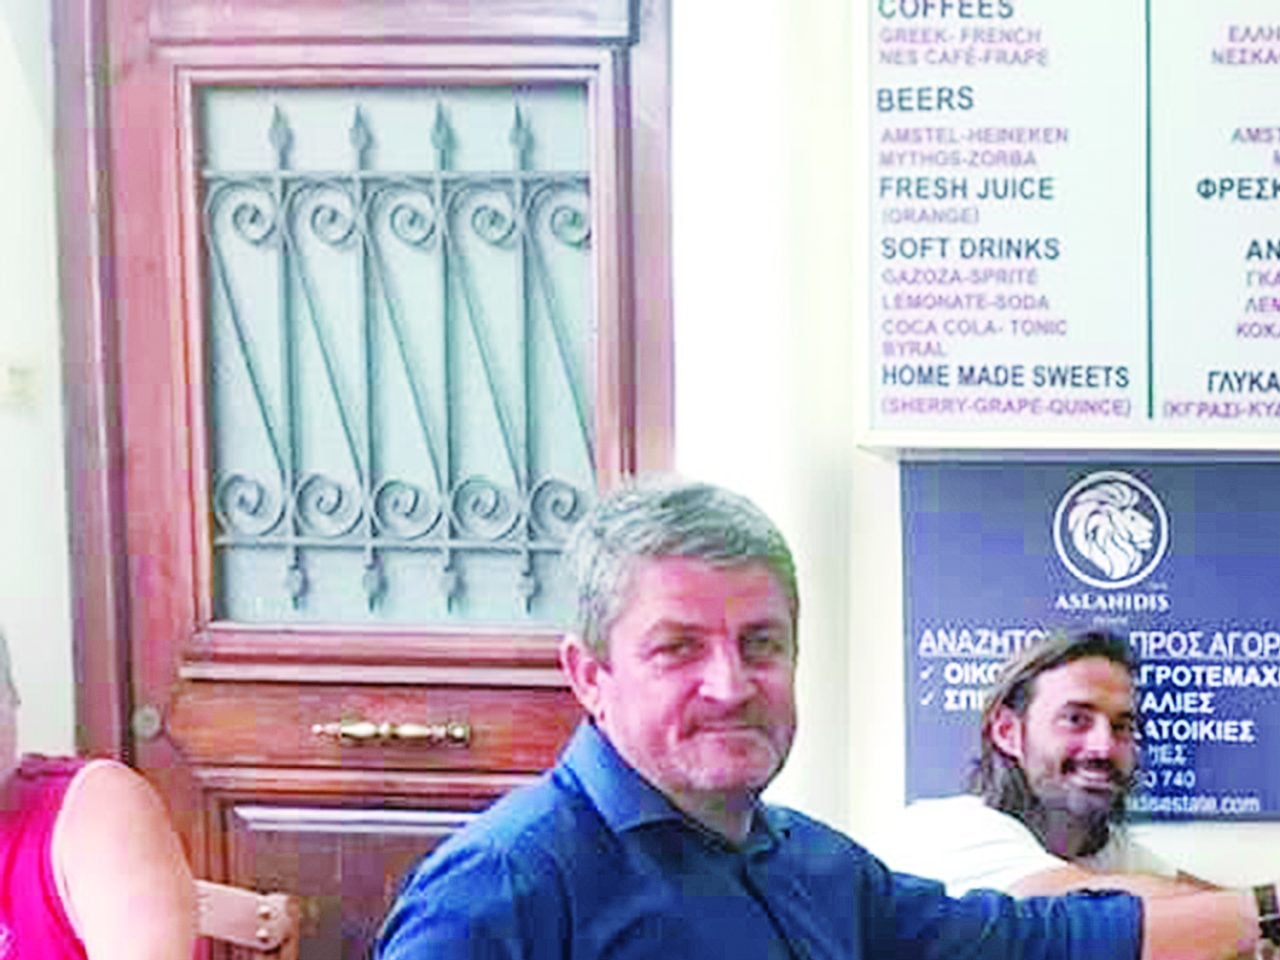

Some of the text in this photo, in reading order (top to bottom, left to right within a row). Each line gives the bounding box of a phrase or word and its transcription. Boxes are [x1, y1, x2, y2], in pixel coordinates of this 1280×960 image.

[878, 0, 1014, 18] COFFEES
[960, 27, 1041, 44] FRENCH
[879, 49, 918, 65] NES
[877, 86, 974, 112] BEERS
[879, 177, 1056, 200] FRESH JUICE
[883, 207, 980, 225] (ORANGE)
[881, 237, 1061, 260] SOFT DRINKS
[881, 320, 937, 336] COCA
[1010, 319, 1068, 336] TONIC
[882, 365, 1130, 388] HOME MADE SWEETS
[1207, 370, 1280, 393] ΓΛΥΚΑ
[1133, 720, 1255, 743] ΑΤΟΙΚΙΕΣ
[1161, 769, 1196, 789] 740
